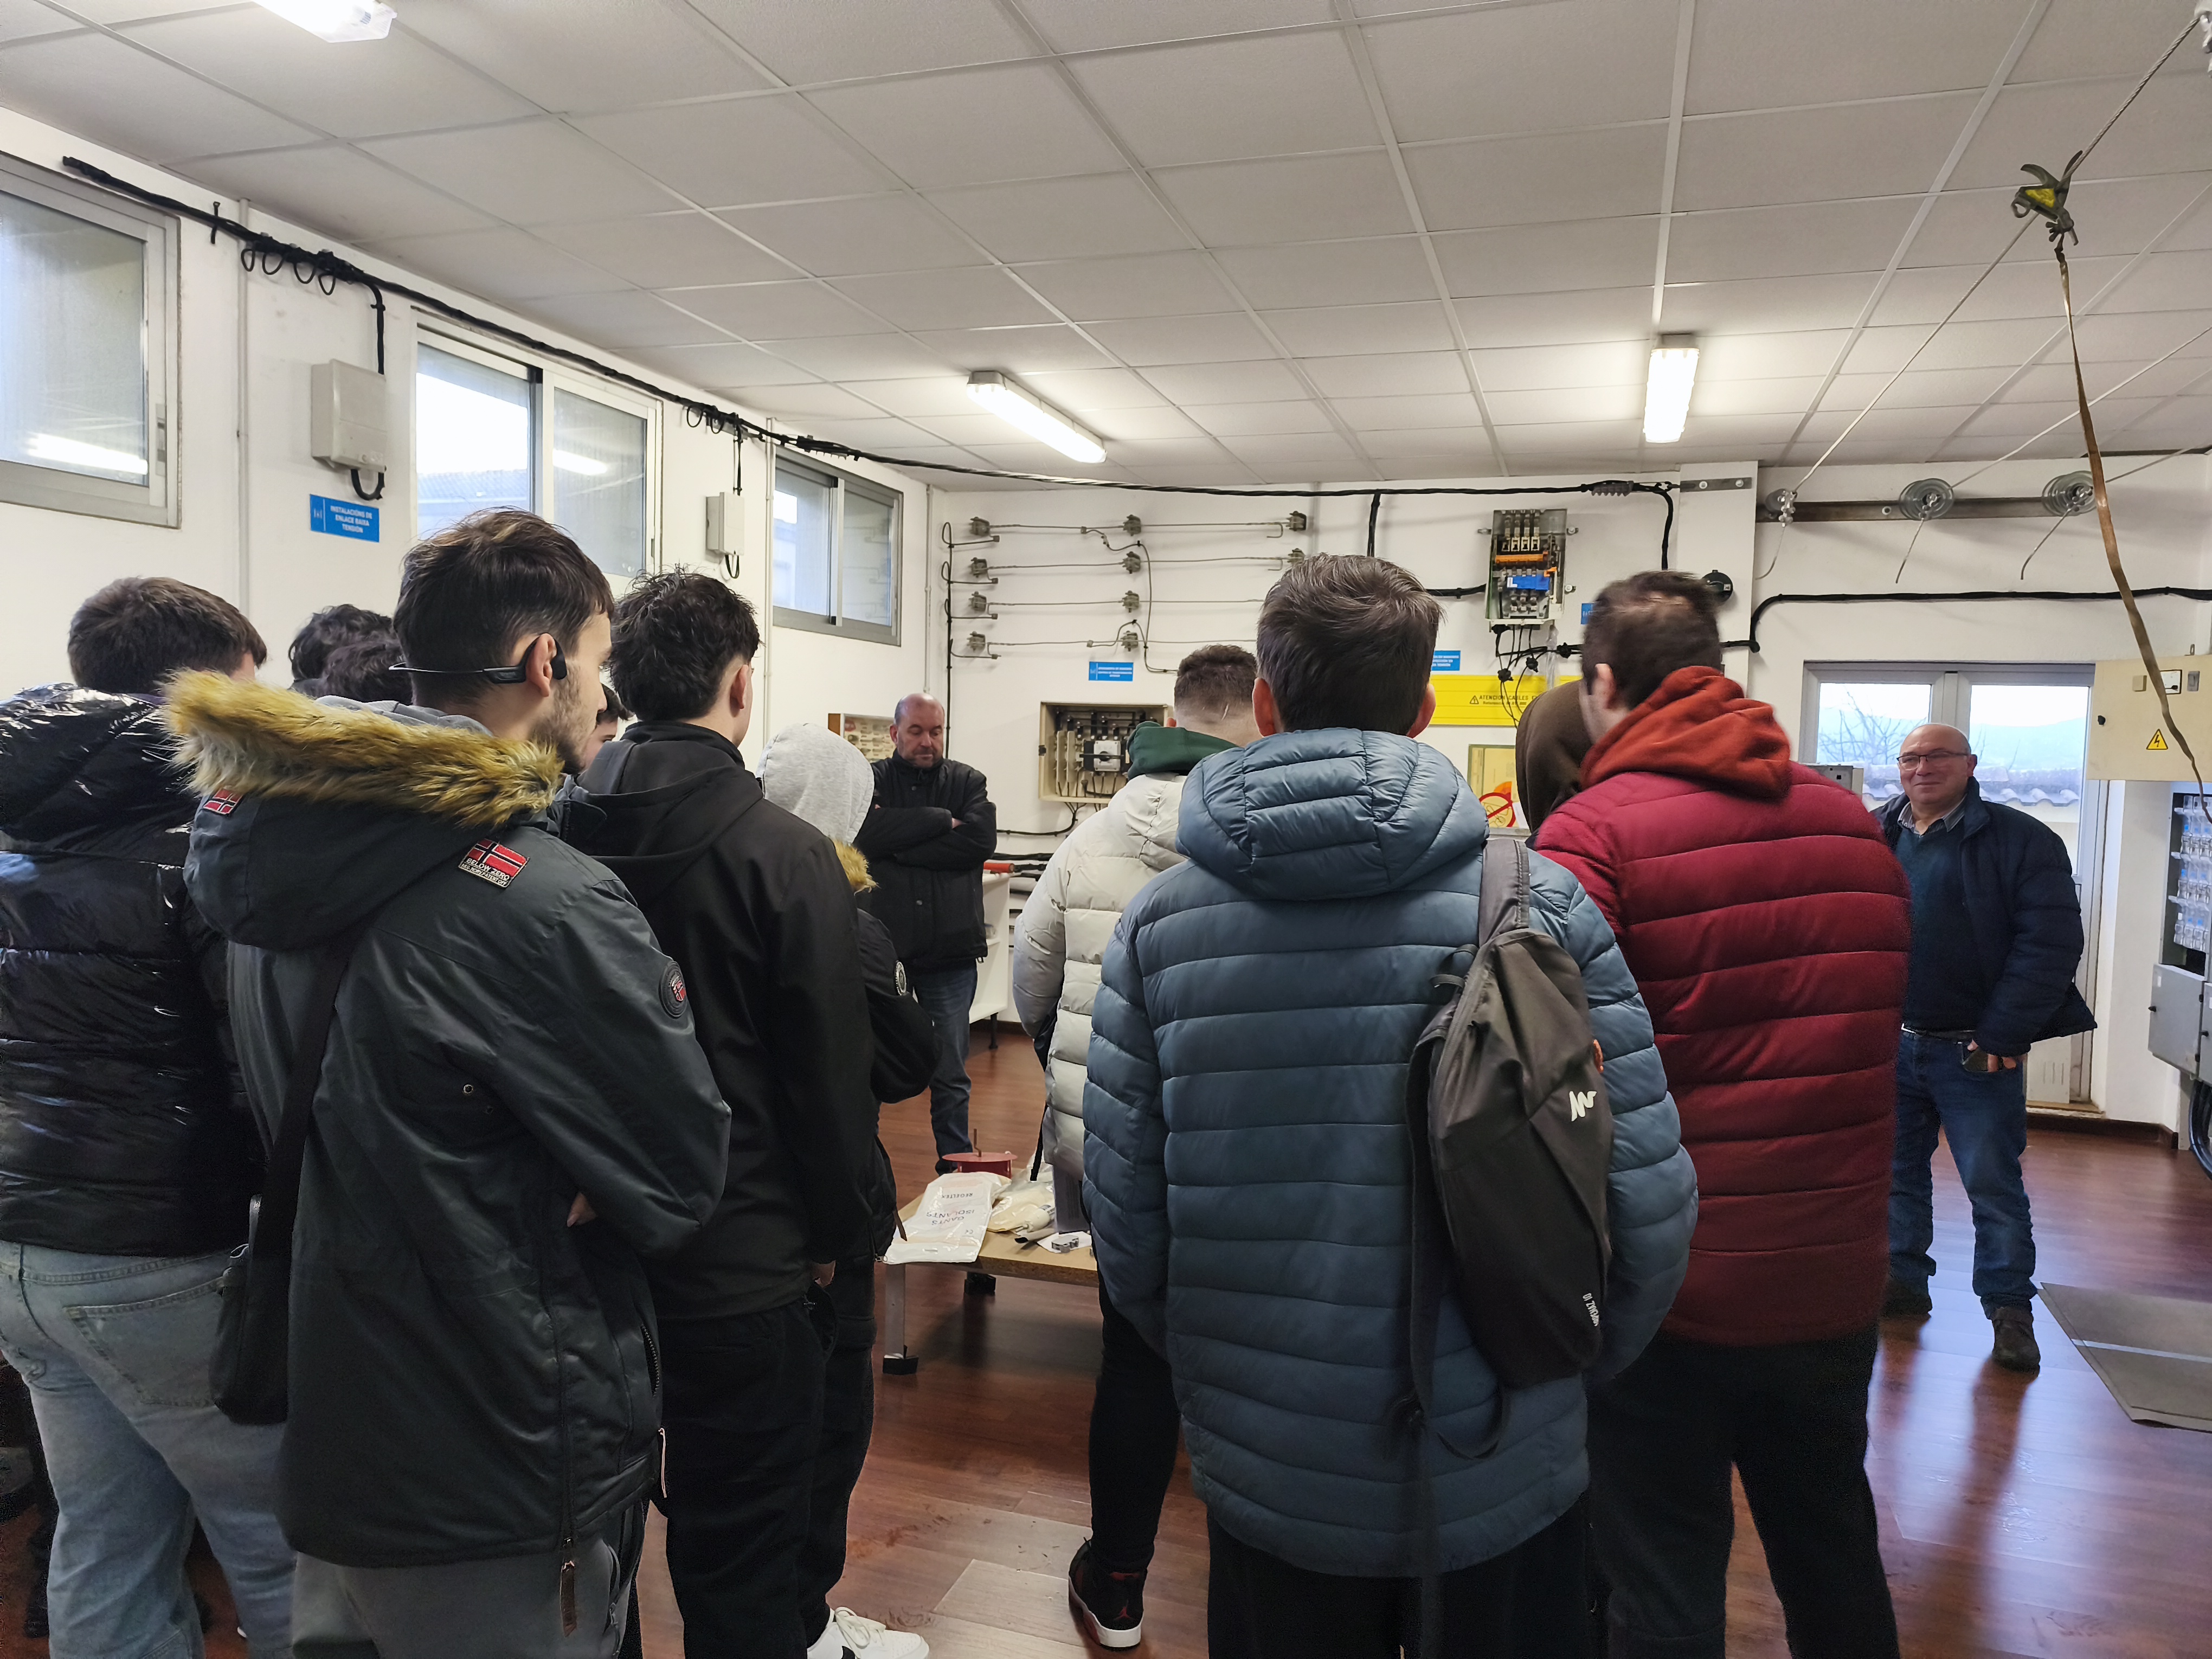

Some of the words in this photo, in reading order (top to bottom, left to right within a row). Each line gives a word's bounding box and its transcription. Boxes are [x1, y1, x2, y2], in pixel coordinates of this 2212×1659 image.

[466, 858, 491, 872] BELOW
[491, 867, 510, 880] ZERO
[926, 1210, 975, 1218] ISOLANTS
[931, 1216, 964, 1226] GANTS
